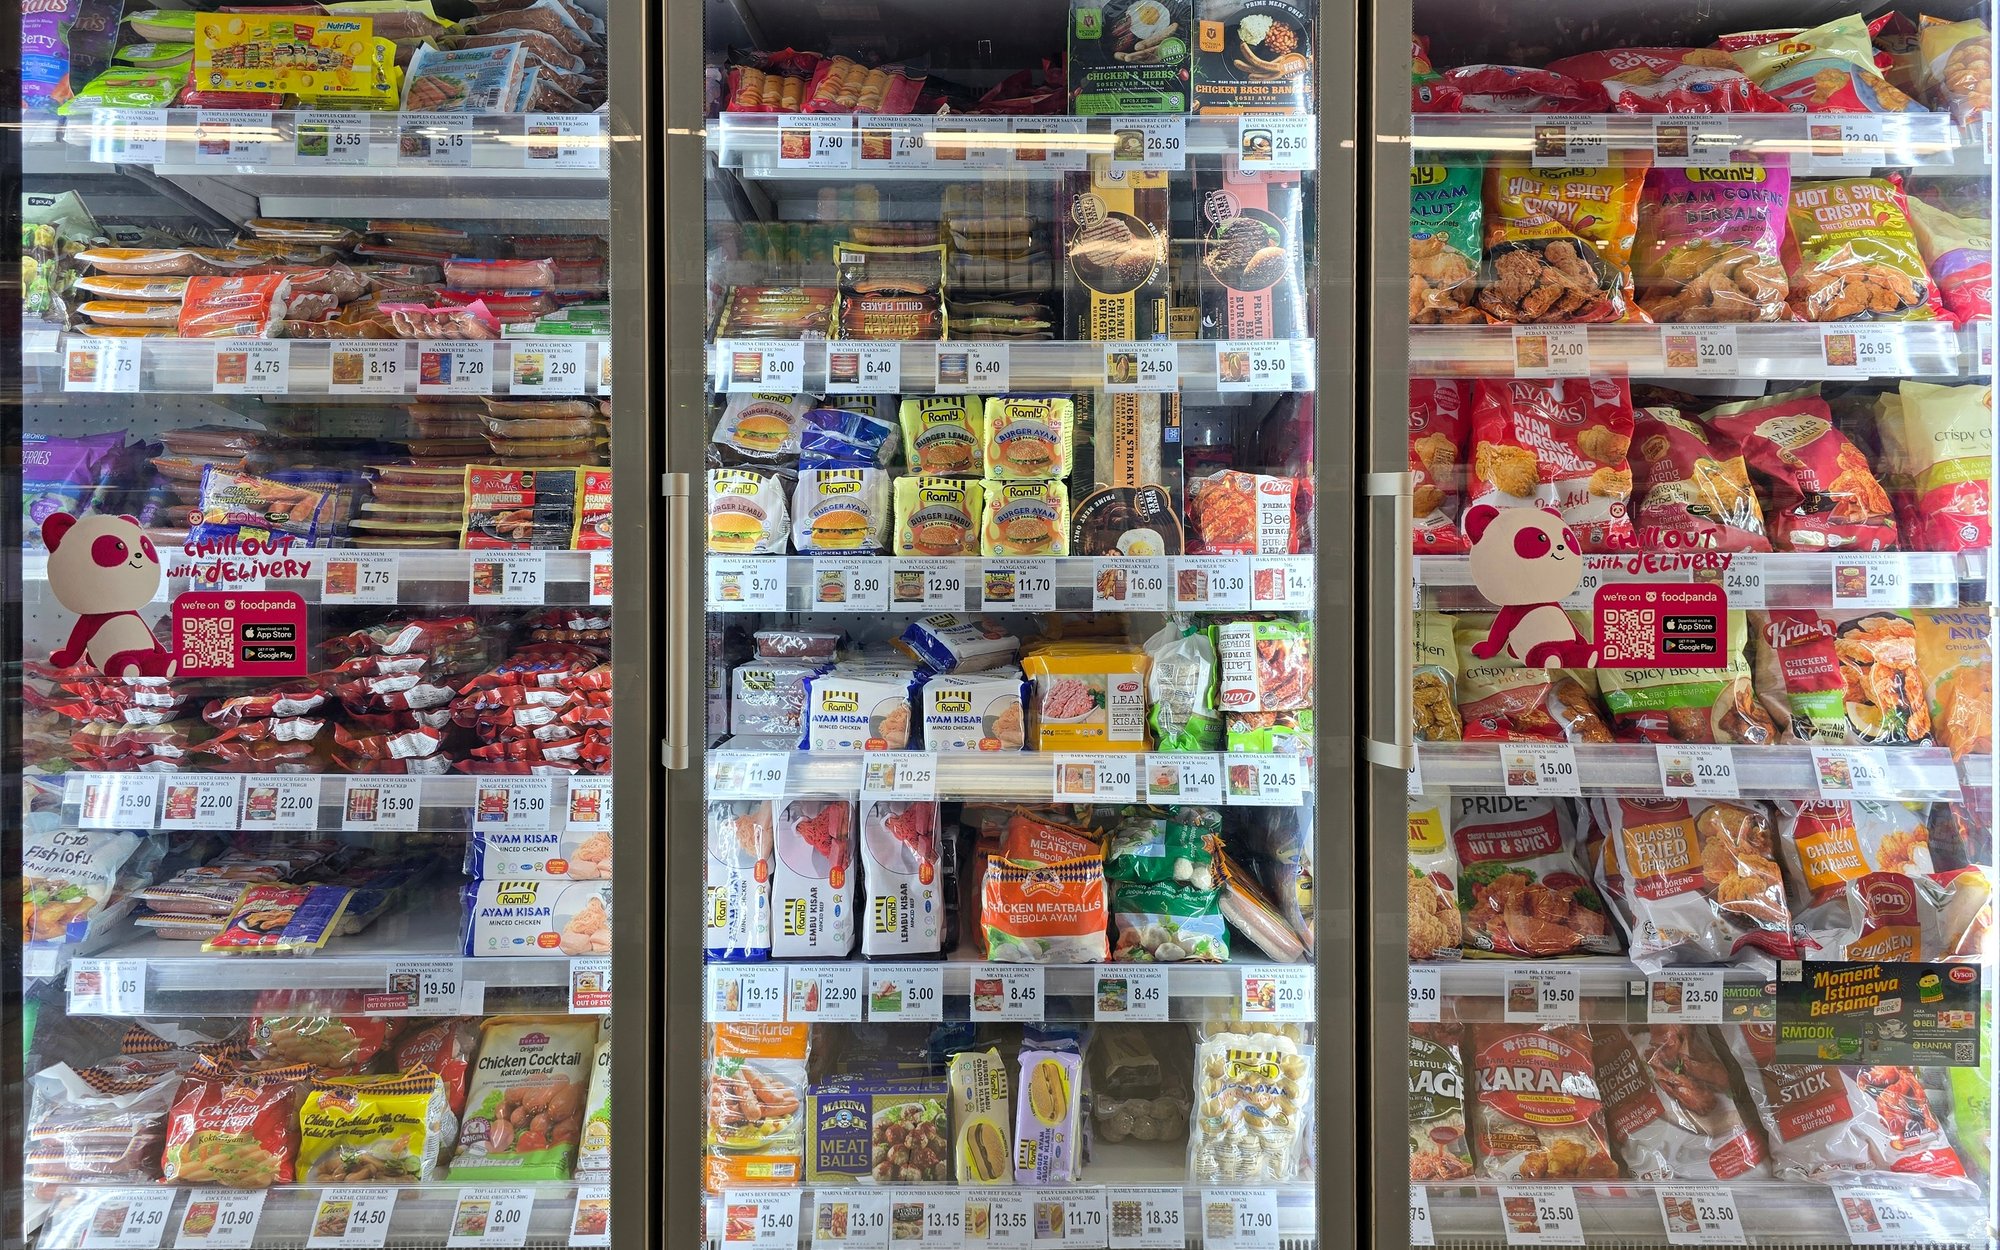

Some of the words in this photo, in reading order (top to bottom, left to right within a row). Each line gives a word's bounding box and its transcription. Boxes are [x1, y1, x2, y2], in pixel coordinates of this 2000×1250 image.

[326, 22, 360, 31] NutriPlus
[1087, 72, 1130, 80] CHICKEN
[1196, 85, 1236, 93] CHICKEN
[1240, 86, 1267, 94] BASIC
[335, 134, 360, 146] 8.55
[818, 136, 842, 148] 7.90
[899, 136, 923, 148] 7.90
[1148, 138, 1180, 150] 26.50
[1508, 178, 1543, 195] HOT
[1550, 182, 1559, 198] &
[1565, 182, 1613, 201] SPICY
[1522, 198, 1578, 218] CRISPY
[861, 302, 886, 310] FLAKES
[887, 302, 922, 310] CHILLI
[864, 314, 918, 323] SAUSAGE
[864, 324, 920, 335] CHICKEN
[1550, 344, 1583, 356] 24.00
[1700, 345, 1732, 356] 32.00
[1859, 343, 1892, 355] 26.95
[254, 361, 280, 373] 4.75
[370, 361, 396, 373] 8.15
[459, 362, 484, 374] 7.20
[551, 362, 576, 374] 2.90
[769, 361, 794, 372] 8.00
[866, 361, 891, 373] 6.40
[976, 361, 1000, 373] 6.40
[1141, 360, 1173, 372] 24.50
[1254, 360, 1285, 371] 39.50
[928, 410, 960, 422] Ramly
[916, 432, 946, 449] BURGER
[948, 432, 974, 444] LEMBU
[826, 483, 856, 494] Ramly
[472, 494, 522, 503] FRANKFURTER
[812, 504, 844, 518] BURGER
[846, 504, 868, 516] AYAM
[242, 536, 296, 556] OUT
[1588, 558, 1622, 570] with
[167, 565, 201, 578] with
[364, 572, 389, 583] 7.75
[511, 572, 536, 583] 7.75
[752, 579, 778, 590] 9.70
[854, 579, 878, 591] 8.90
[928, 579, 960, 591] 12.90
[1018, 579, 1050, 591] 11.70
[1130, 578, 1162, 590] 16.60
[1212, 578, 1244, 590] 10.30
[1727, 575, 1760, 587] 24.90
[1629, 594, 1640, 602] on
[1662, 592, 1717, 604] foodpanda
[208, 602, 219, 610] on
[240, 600, 296, 611] foodpanda
[257, 631, 271, 639] App
[258, 652, 278, 660] Google
[279, 652, 292, 660] Play
[1785, 656, 1828, 669] CHICKEN
[1787, 665, 1834, 677] KARAAGE
[1112, 695, 1144, 704] LEAN
[828, 703, 852, 712] Ramly
[812, 715, 838, 723] AYAM
[840, 716, 868, 724] KISAR
[1113, 717, 1143, 726] KISAR
[1540, 762, 1572, 775] 15.00
[1698, 765, 1729, 777] 20.20
[748, 770, 781, 781] 11.90
[899, 770, 930, 782] 10.25
[1099, 772, 1130, 784] 12.00
[1183, 774, 1215, 785] 11.40
[1263, 774, 1296, 786] 20.45
[119, 796, 151, 808] 15.90
[200, 796, 232, 808] 22.00
[280, 798, 313, 809] 22.00
[382, 798, 414, 810] 15.90
[513, 798, 544, 810] 15.90
[1469, 842, 1494, 855] HOT
[1501, 840, 1511, 852] &
[1514, 836, 1552, 852] SPICY
[1638, 839, 1688, 860] FRIED
[1640, 856, 1690, 873] CHICKEN
[503, 894, 532, 904] Ramly
[481, 907, 513, 917] AYAM
[516, 907, 550, 916] KISAR
[988, 901, 1033, 912] CHICKEN
[1037, 901, 1100, 912] MEATBALLS
[1010, 914, 1046, 923] BEBOLA
[1050, 914, 1077, 922] AYAM
[1814, 966, 1881, 989] Moment
[424, 982, 455, 994] 19.50
[747, 988, 778, 1000] 19.15
[824, 988, 856, 1000] 22.90
[908, 988, 933, 1000] 5.00
[1011, 988, 1036, 1000] 8.45
[1134, 988, 1159, 1000] 8.45
[1824, 978, 1898, 1001] Istimewa
[1542, 989, 1574, 1001] 19.50
[1686, 990, 1718, 1002] 23.50
[1810, 994, 1879, 1016] Bersama
[1782, 1026, 1834, 1039] RM100K
[478, 1055, 526, 1070] Chicken
[529, 1052, 581, 1066] Cocktail
[1780, 1071, 1831, 1104] STICK
[822, 1101, 866, 1114] MARINA
[1792, 1112, 1815, 1126] KEPAK
[1816, 1104, 1836, 1119] AYAM
[1801, 1115, 1832, 1132] BUFFALO
[820, 1140, 868, 1153] MEAT
[821, 1154, 868, 1167] BALLS
[130, 1211, 162, 1224] 14.50
[220, 1211, 253, 1224] 10.90
[353, 1211, 385, 1224] 14.50
[494, 1210, 520, 1223] 8.00
[852, 1213, 884, 1226] 13.10
[927, 1213, 960, 1226] 13.15
[1068, 1211, 1100, 1224] 11.70
[1146, 1210, 1178, 1224] 18.35
[1240, 1213, 1272, 1226] 17.90
[1540, 1207, 1574, 1220] 25.50
[1700, 1207, 1734, 1220] 23.50
[761, 1214, 793, 1228] 15.40
[994, 1213, 1026, 1227] 13.55
